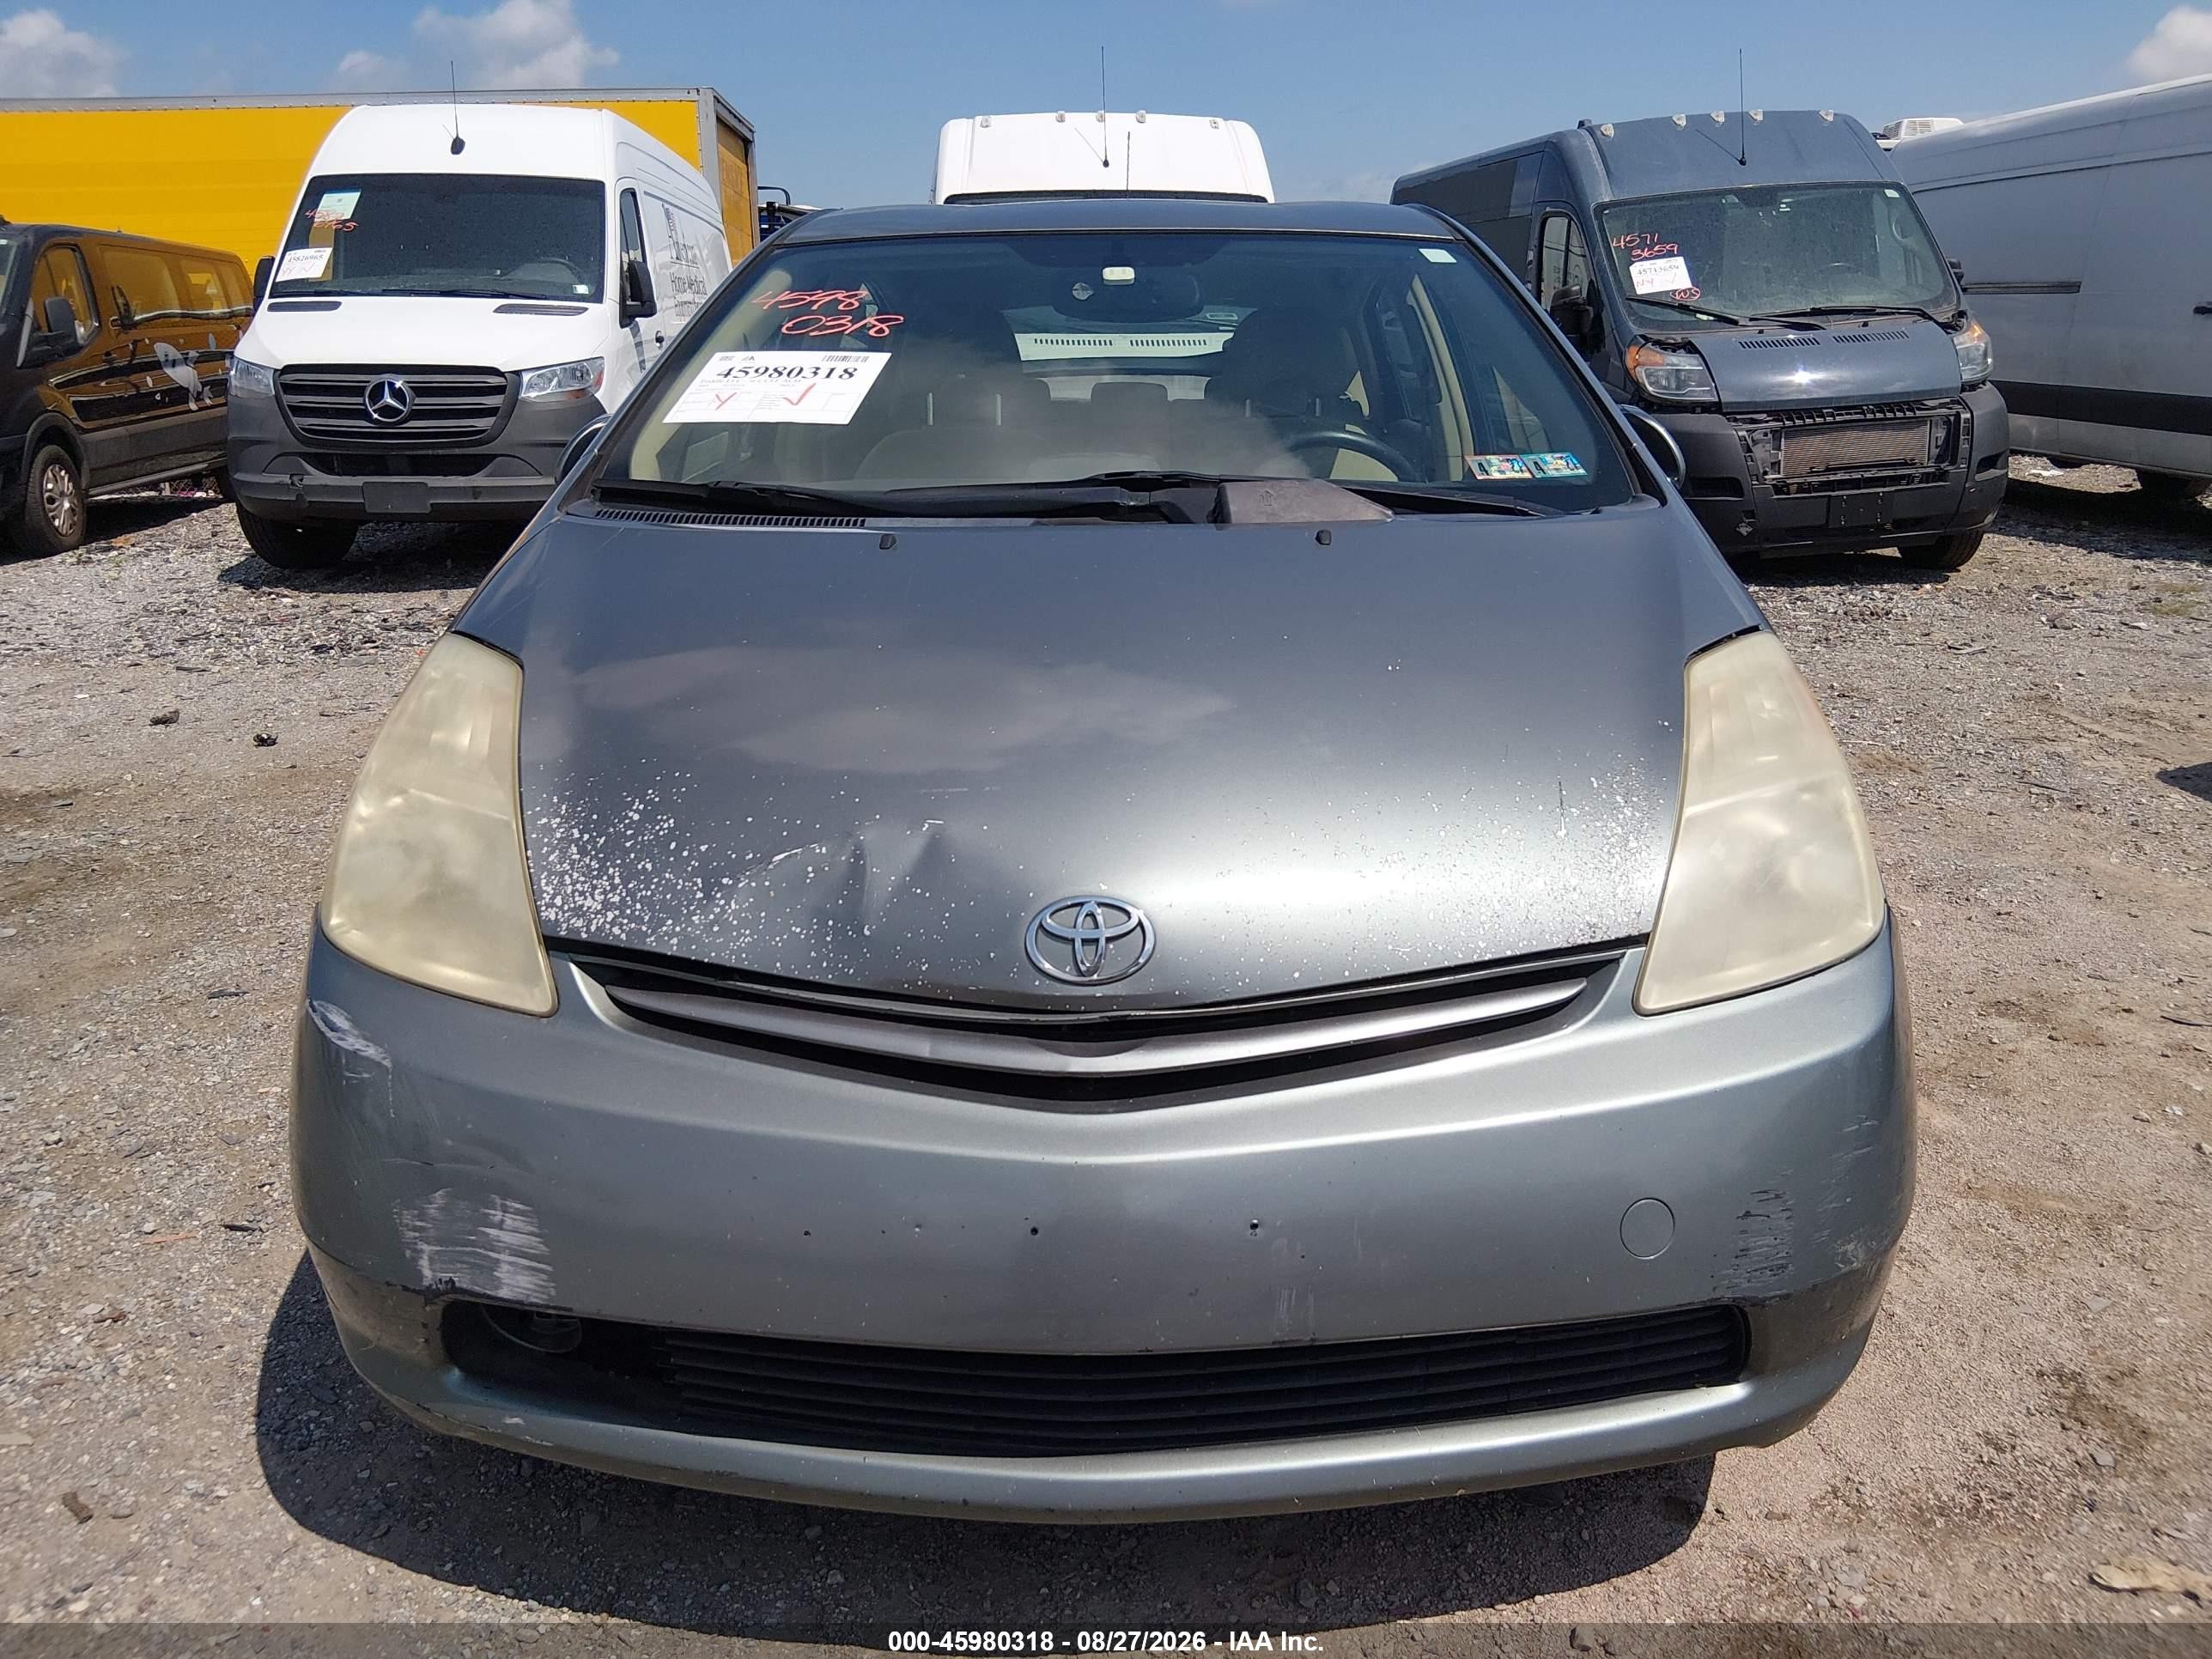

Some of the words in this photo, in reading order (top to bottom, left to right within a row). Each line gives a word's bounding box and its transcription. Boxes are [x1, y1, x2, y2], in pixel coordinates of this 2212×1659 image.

[1613, 233, 1658, 249] 4571
[1631, 243, 1679, 261] 3659
[670, 272, 687, 294] Home
[687, 275, 708, 296] Medical
[750, 289, 866, 310] 4598
[781, 315, 904, 337] 0318
[717, 366, 858, 380] 45980318
